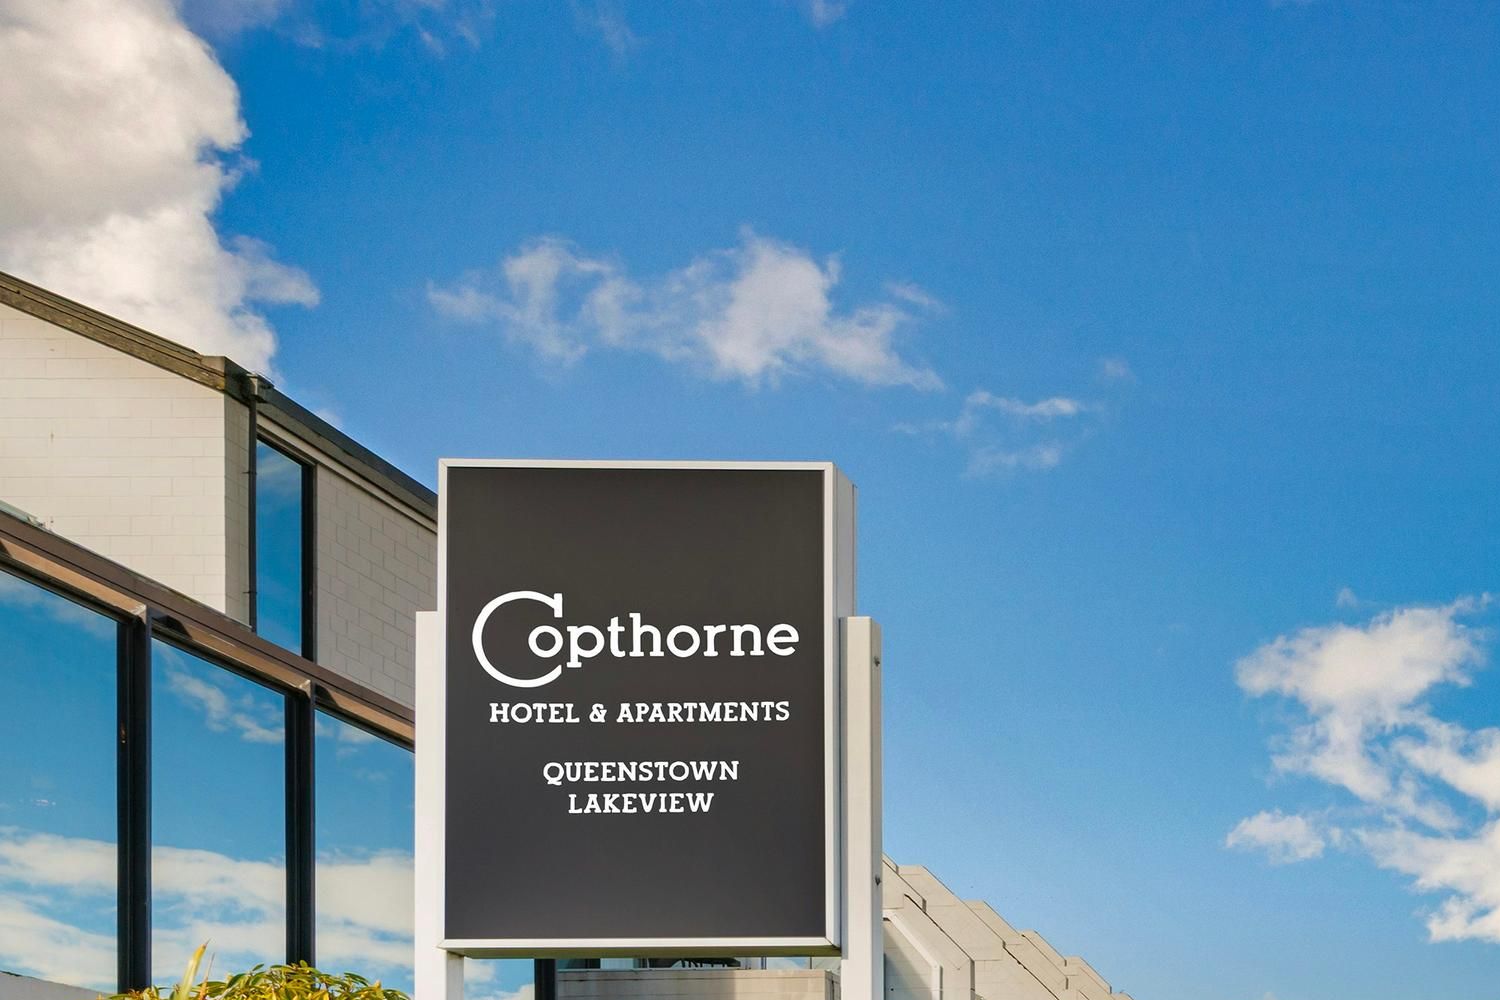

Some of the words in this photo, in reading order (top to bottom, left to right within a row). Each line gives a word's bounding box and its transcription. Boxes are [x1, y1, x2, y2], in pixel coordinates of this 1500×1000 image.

[471, 590, 800, 688] Copthorne
[489, 702, 580, 723] HOTEL
[588, 702, 608, 723] &
[615, 700, 790, 723] APARTMENTS
[542, 760, 740, 786] QUEENSTOWN
[568, 792, 715, 814] LAKEVIEW
